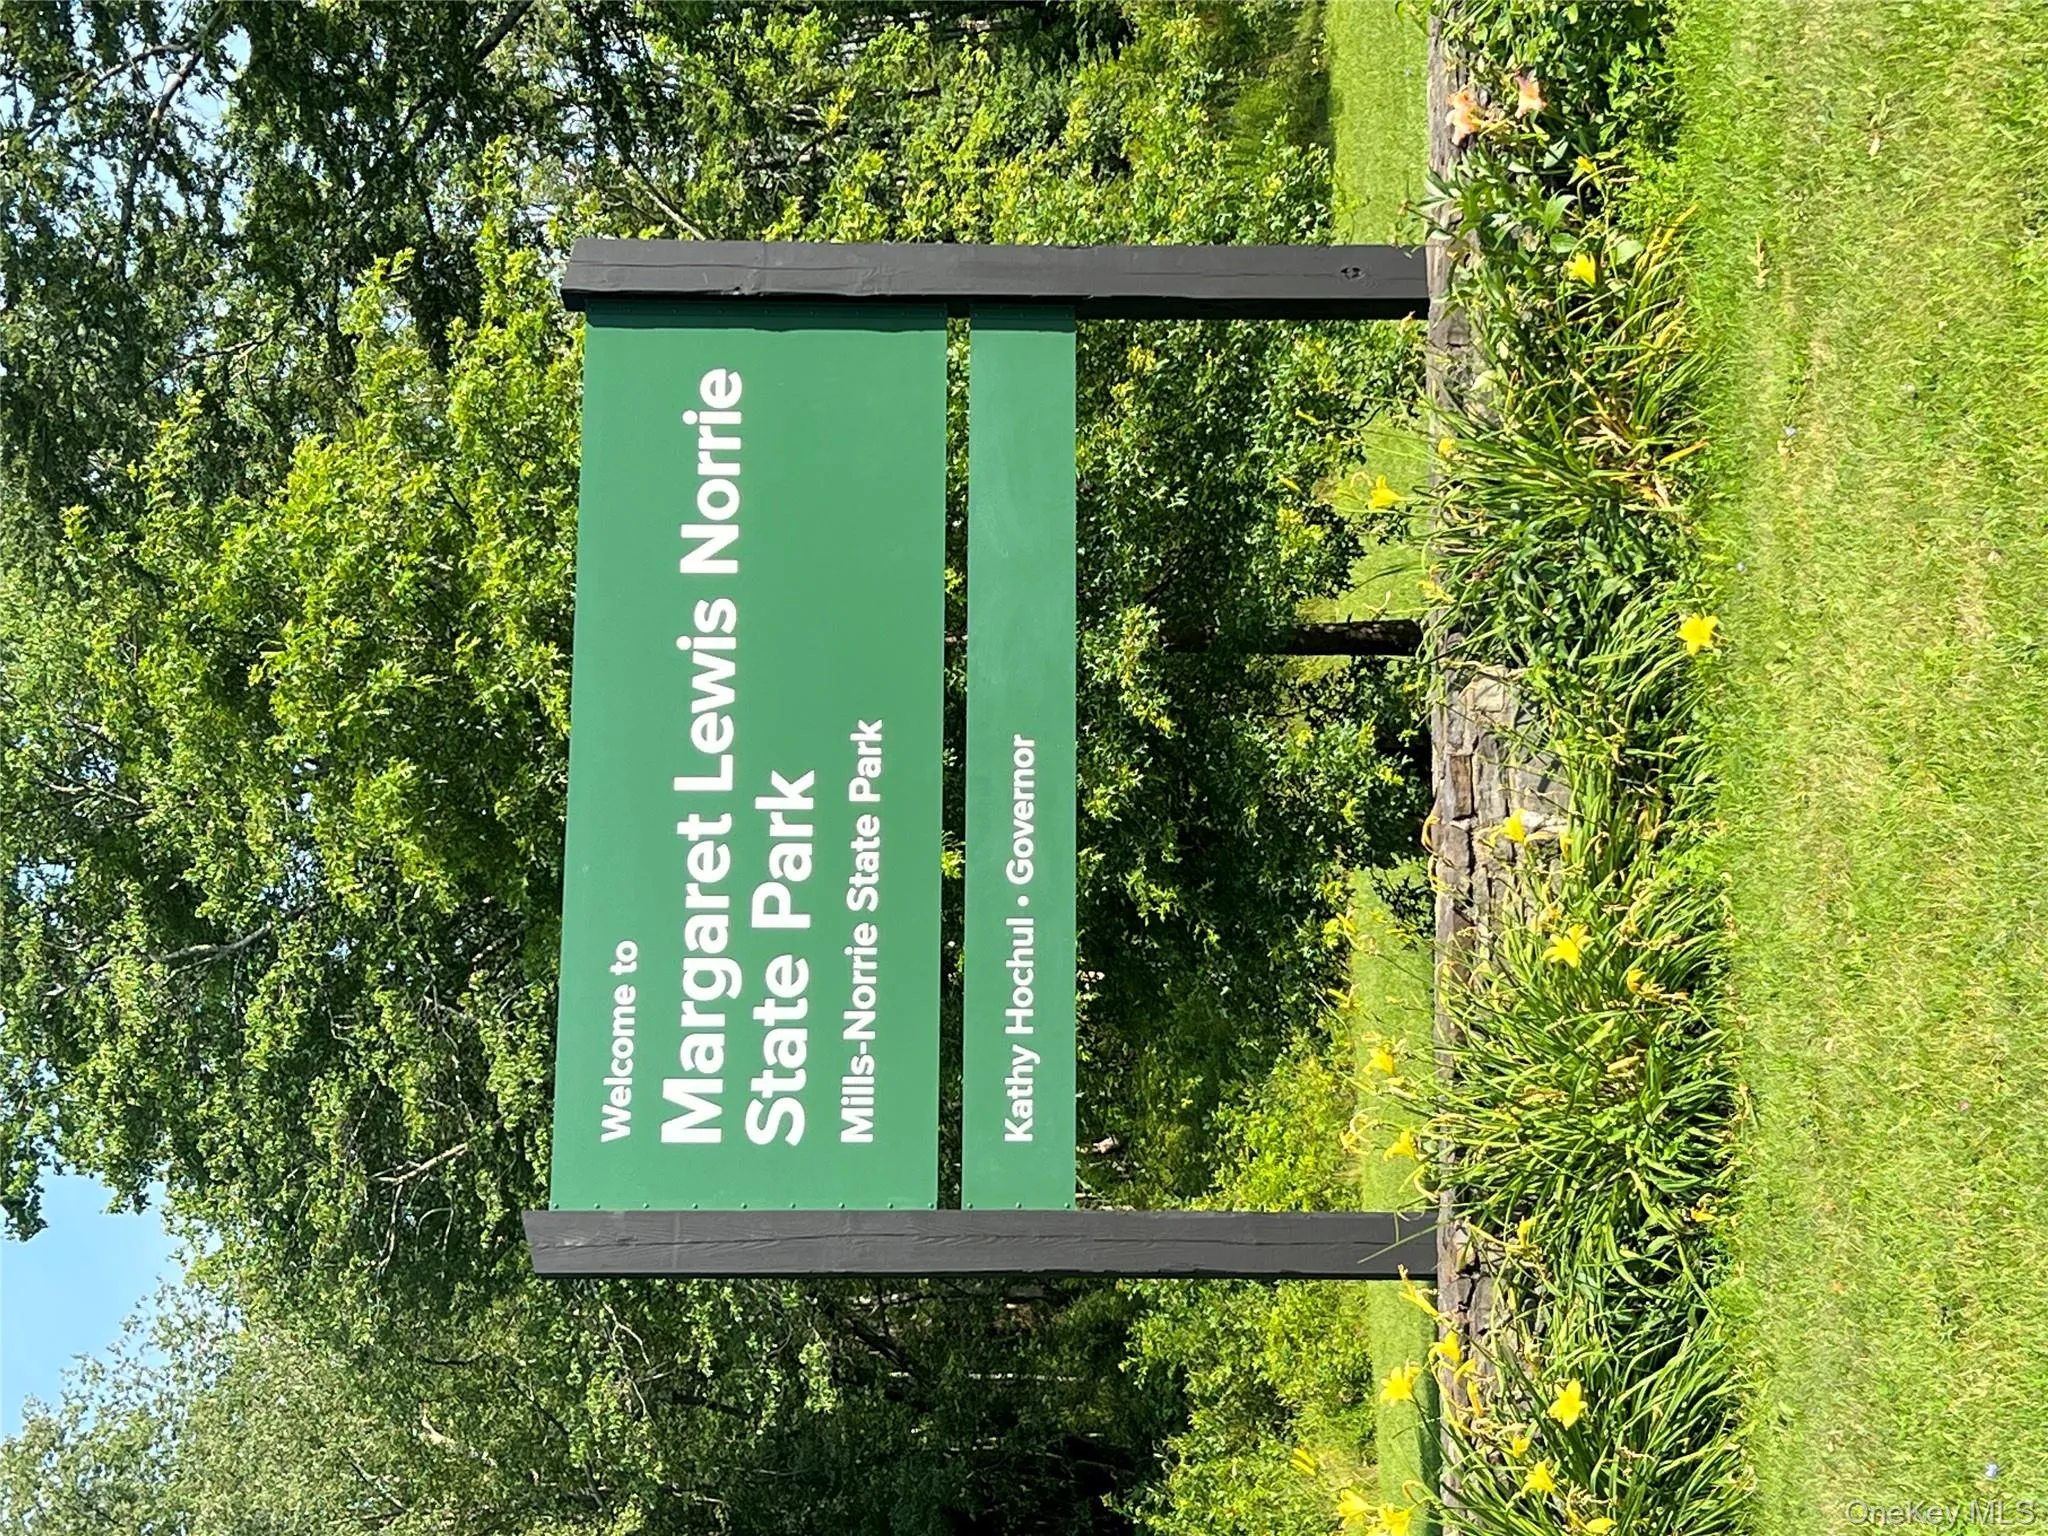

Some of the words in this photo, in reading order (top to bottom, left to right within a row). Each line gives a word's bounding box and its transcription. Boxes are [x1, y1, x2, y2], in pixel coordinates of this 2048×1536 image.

[680, 369, 742, 574] Norrie
[673, 598, 737, 791] Lewis
[849, 720, 882, 802] Park
[751, 770, 815, 928] Park
[846, 815, 880, 912] State
[1006, 734, 1035, 885] Governor
[610, 941, 638, 975] to
[661, 813, 742, 1143] Margaret
[841, 923, 878, 1143] Mills-Norrie
[1005, 918, 1034, 1034] Hochul
[601, 984, 636, 1142] Welcome
[745, 955, 809, 1146] State
[1005, 1044, 1040, 1142] Kathy
